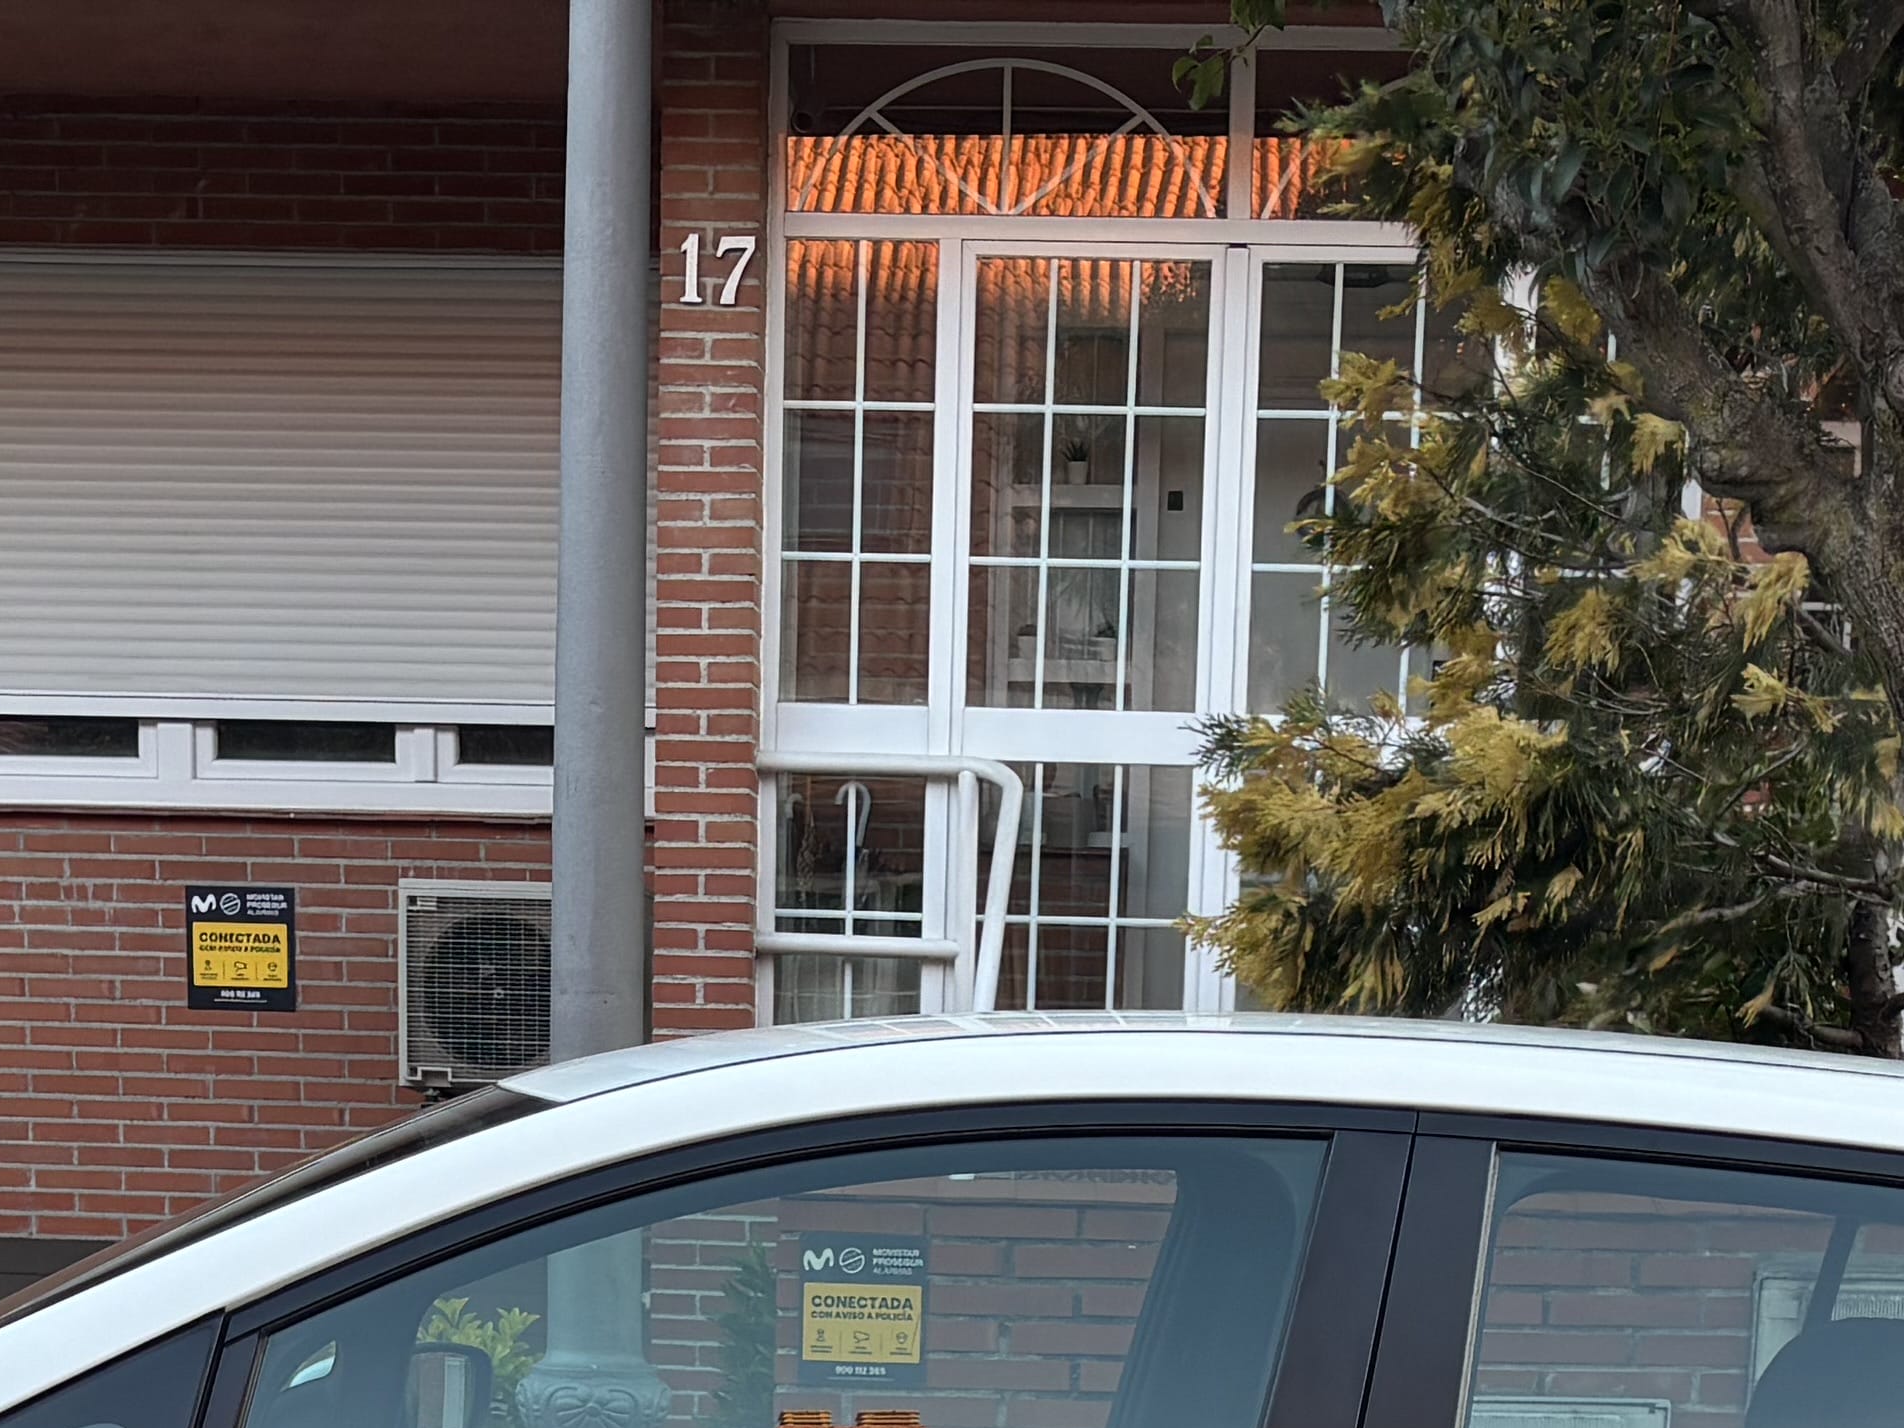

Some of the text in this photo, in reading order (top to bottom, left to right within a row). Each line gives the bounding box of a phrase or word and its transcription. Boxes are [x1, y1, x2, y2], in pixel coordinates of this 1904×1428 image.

[679, 233, 756, 305] 17
[199, 932, 281, 944] CONECTADA
[811, 1295, 913, 1311] CONECTADA
[811, 1310, 833, 1319] CON
[835, 1311, 865, 1320] AVISO
[867, 1311, 873, 1320] A
